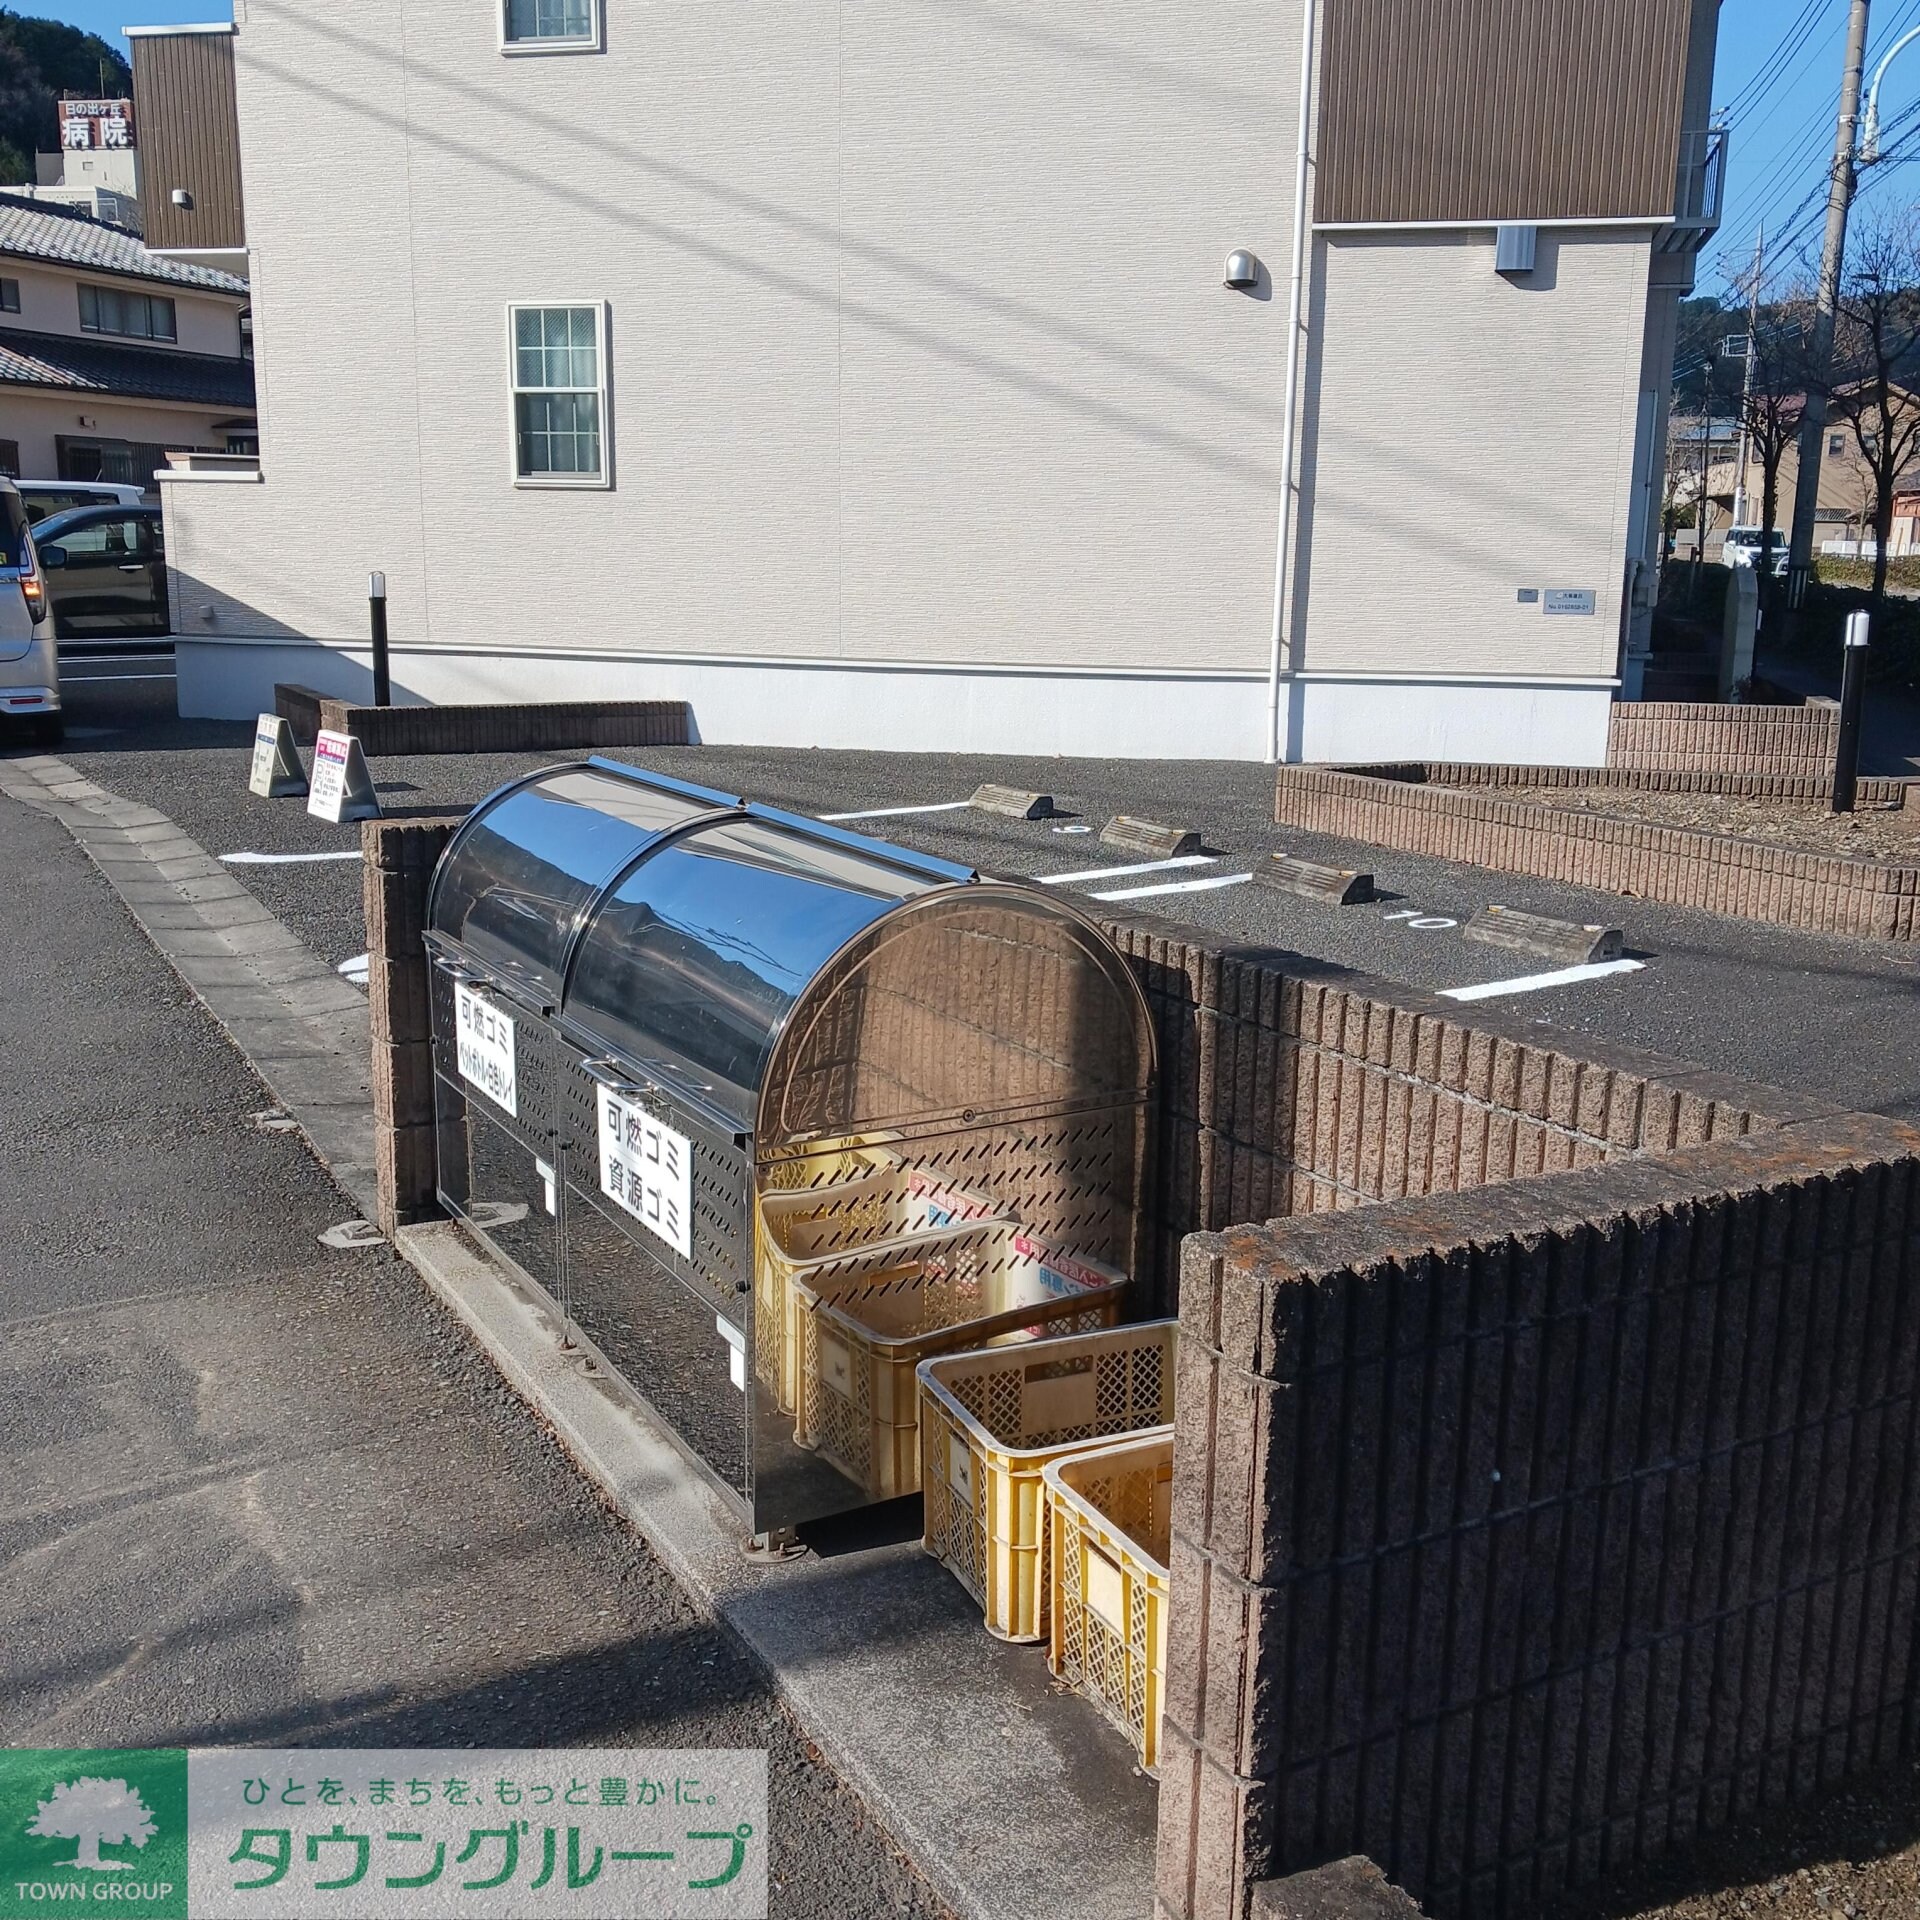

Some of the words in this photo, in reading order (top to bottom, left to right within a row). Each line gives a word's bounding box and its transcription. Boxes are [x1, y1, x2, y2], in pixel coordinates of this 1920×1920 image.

[62, 117, 127, 148] 病院
[1383, 910, 1457, 928] 10
[461, 994, 508, 1055] 可燃ゴミ
[607, 1098, 680, 1181] 可燃ゴミ
[608, 1154, 680, 1241] 資源ゴミ
